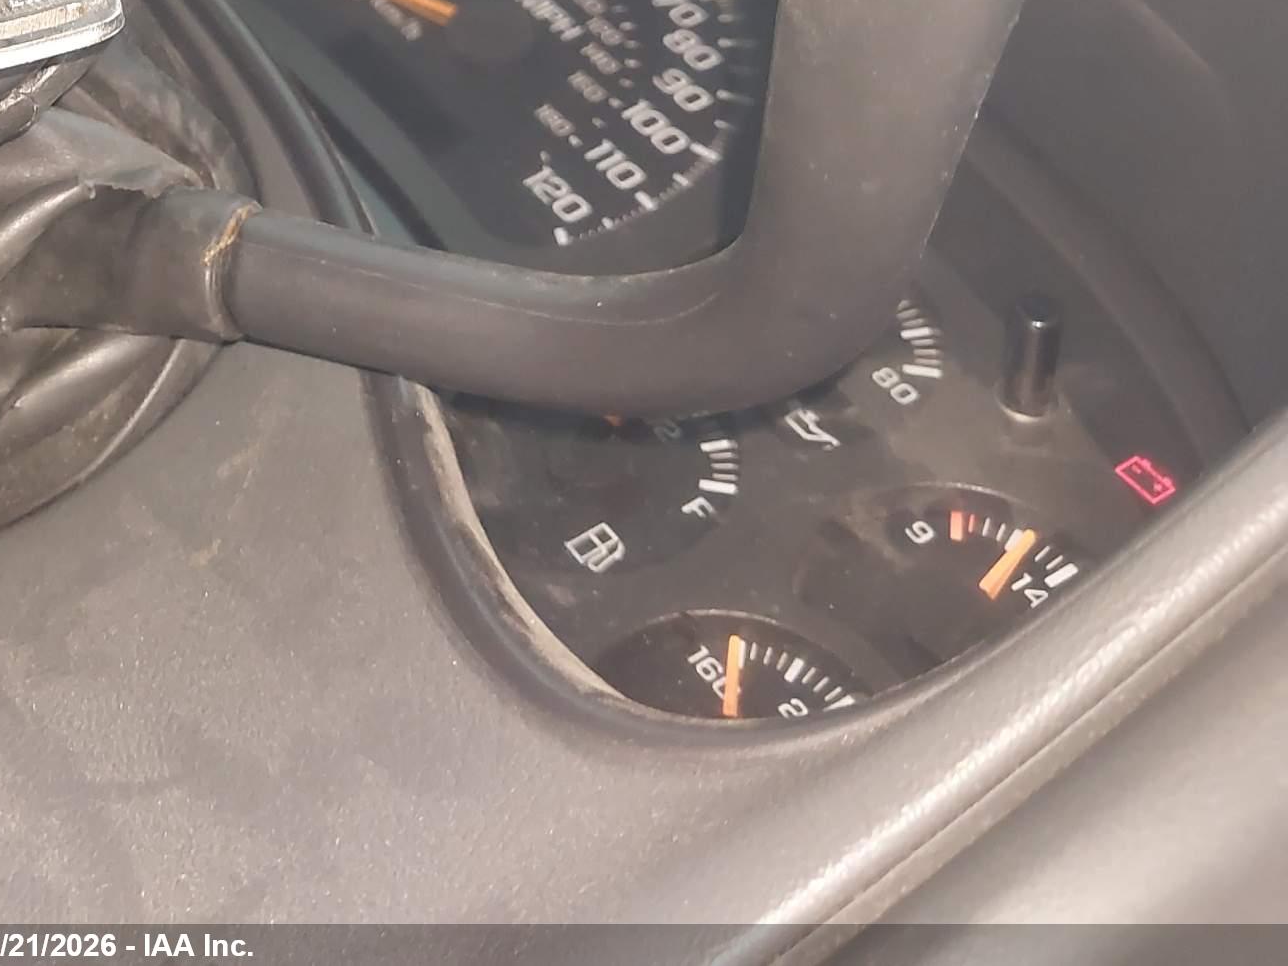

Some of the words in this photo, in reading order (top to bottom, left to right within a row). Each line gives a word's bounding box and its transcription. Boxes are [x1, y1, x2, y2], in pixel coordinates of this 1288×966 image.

[662, 29, 724, 71] 80
[651, 68, 714, 112] 90
[621, 98, 691, 155] 100
[583, 138, 647, 190] 110
[522, 165, 593, 223] 120
[871, 366, 919, 406] 80
[681, 496, 715, 518] F
[905, 520, 936, 545] 9
[1011, 572, 1049, 609] 14
